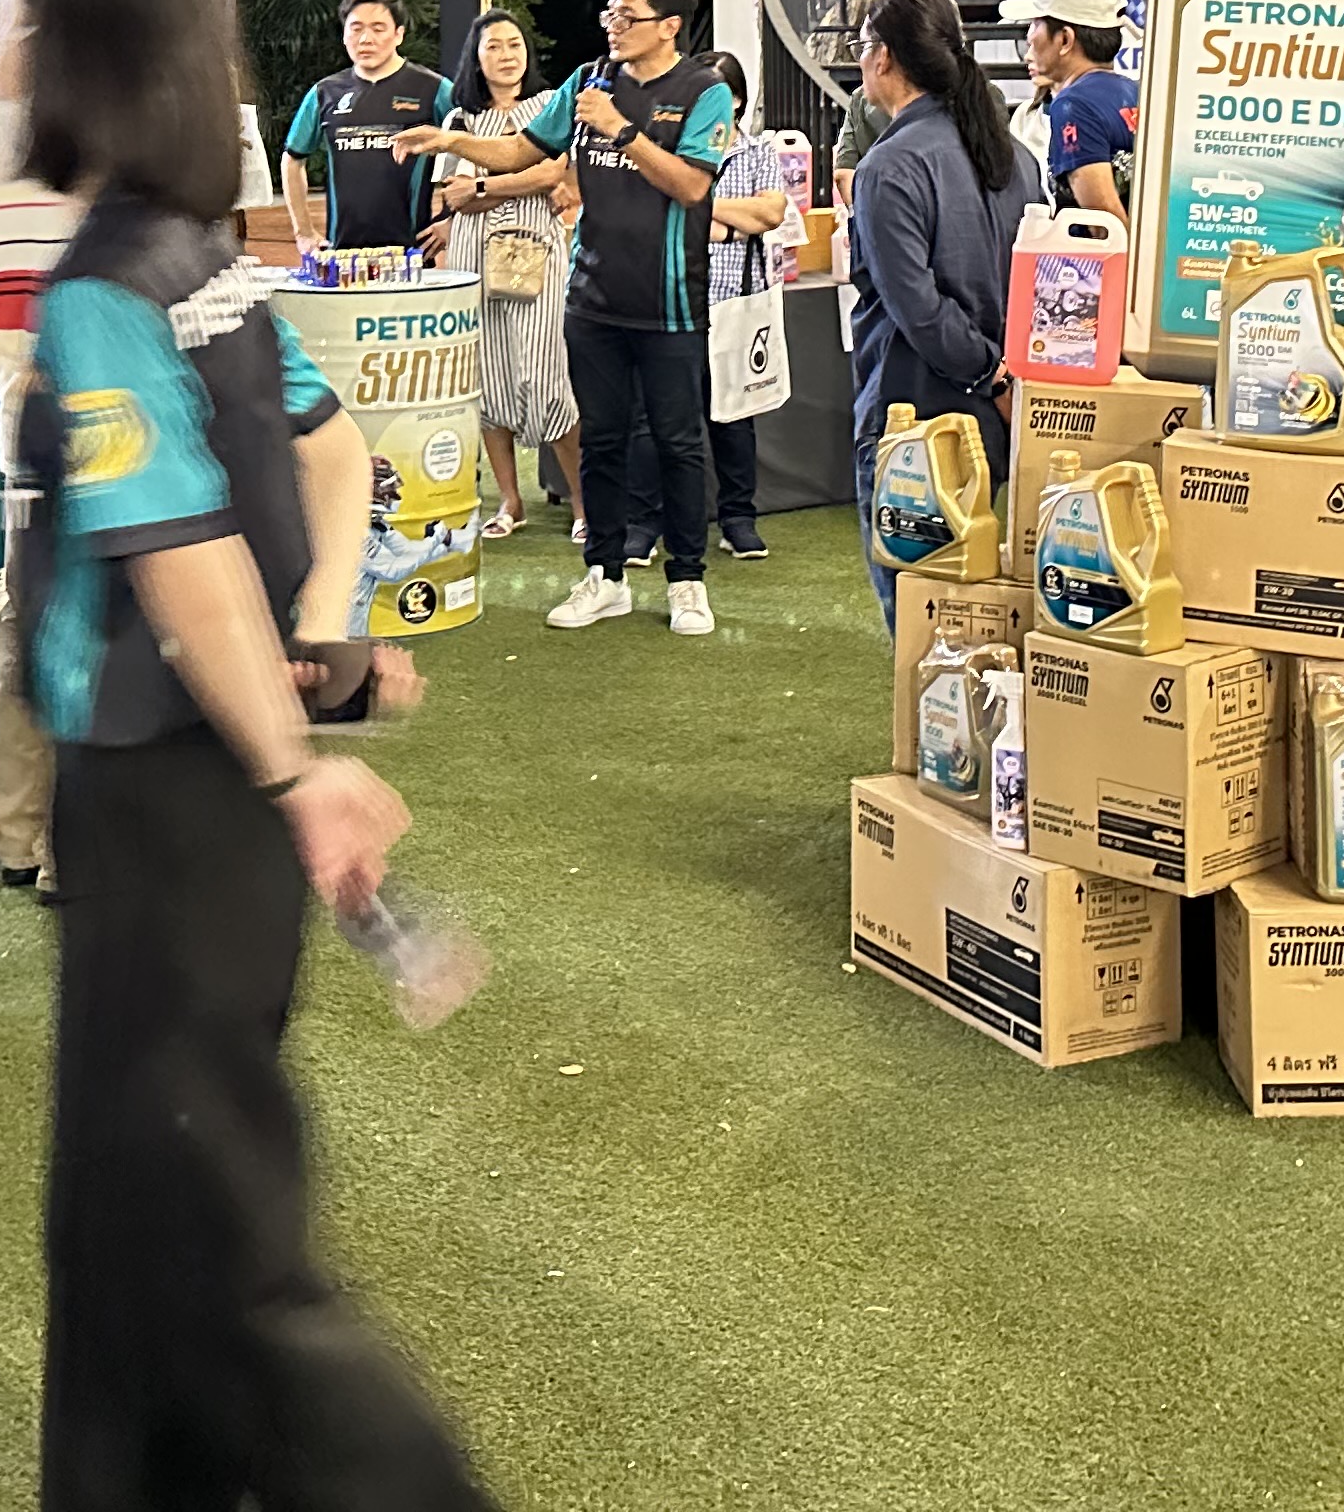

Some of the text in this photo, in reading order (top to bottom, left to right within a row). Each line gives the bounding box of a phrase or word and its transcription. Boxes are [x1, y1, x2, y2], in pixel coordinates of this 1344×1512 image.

[1196, 94, 1282, 123] 3000
[1291, 99, 1311, 124] E
[335, 138, 365, 150] THE
[1195, 129, 1269, 143] EXCELLENT
[588, 149, 620, 168] THE
[1194, 143, 1286, 158] & PROTECTION
[1188, 203, 1258, 224] 5W-30
[1187, 221, 1268, 236] FULLY SYNTHETIC
[1186, 238, 1218, 251] ACEA
[1181, 307, 1198, 320] 6L
[1239, 311, 1301, 325] PETRONAS
[356, 306, 479, 341] PETRONA
[1237, 322, 1300, 343] Syntium
[1238, 343, 1275, 356] 5000
[1030, 398, 1097, 410] PETRONAS
[1030, 411, 1096, 432] SYNTIUM
[1180, 465, 1250, 482] PETRONAS
[1180, 478, 1250, 505] SYNTIUM
[1030, 651, 1089, 672] PETRONAS
[1031, 665, 1089, 697] SYNTIUM
[1143, 716, 1184, 730] PETRONAS
[857, 798, 895, 825] PETRONAS
[858, 814, 895, 849] SYNTIUM
[1267, 1057, 1276, 1071] 4
[1283, 1055, 1312, 1071] ลิตร
[1318, 1054, 1338, 1070] ฟรี
